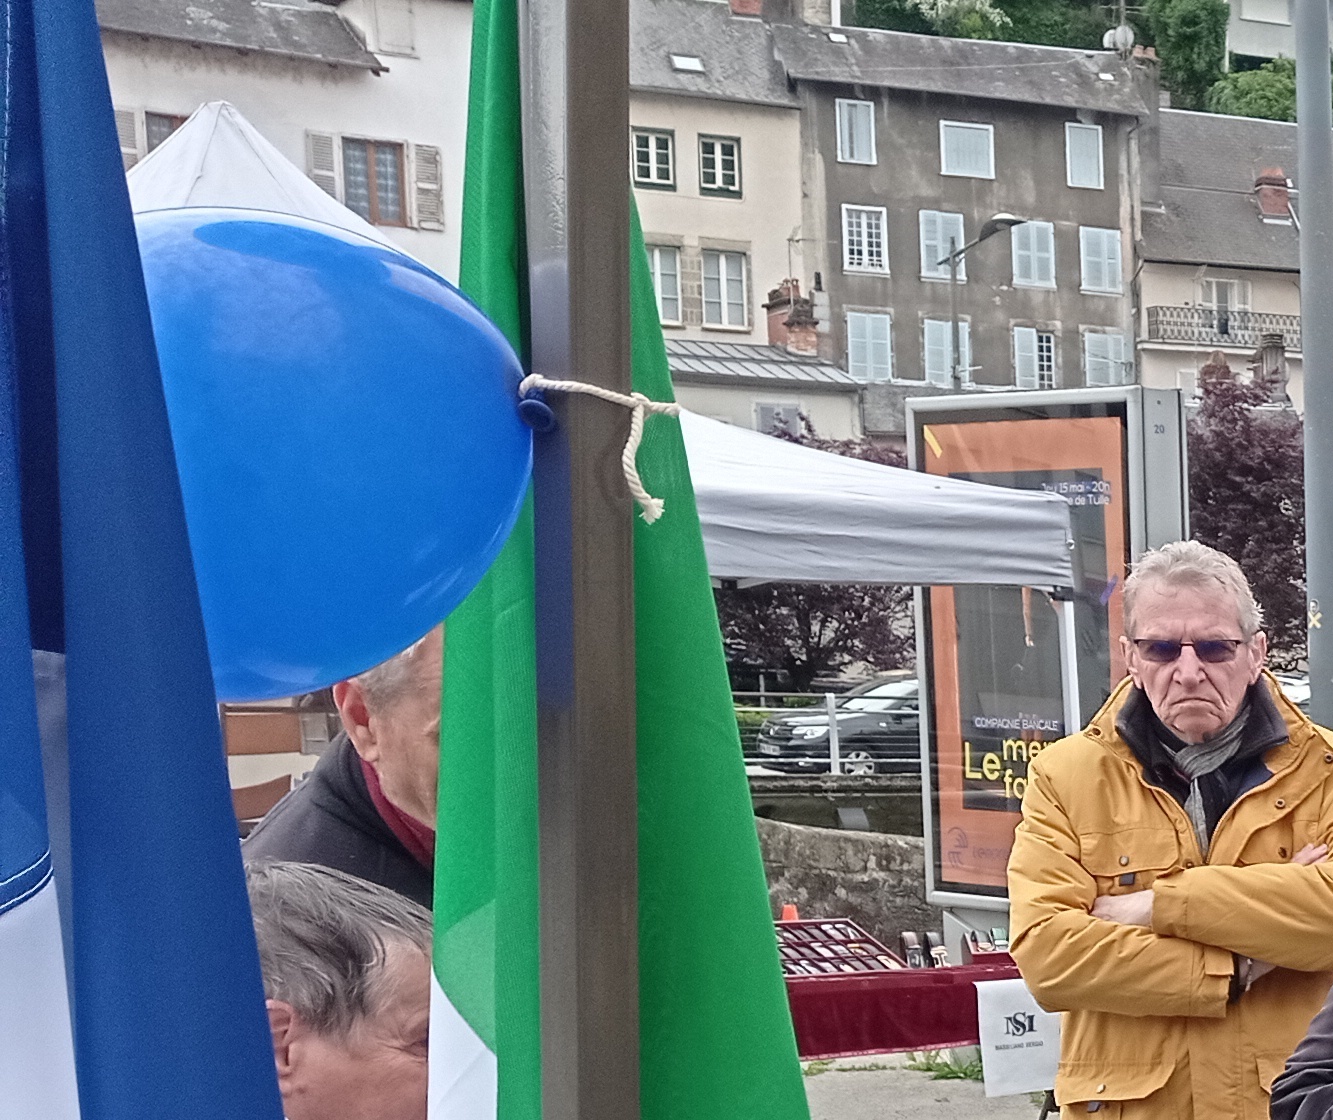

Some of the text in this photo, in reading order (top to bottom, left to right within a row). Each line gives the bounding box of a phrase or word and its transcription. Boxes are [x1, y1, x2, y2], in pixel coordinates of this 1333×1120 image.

[1154, 424, 1165, 434] 20
[1059, 482, 1068, 493] 15
[1069, 482, 1085, 493] mai
[1092, 480, 1111, 494] 20h
[1087, 493, 1111, 506] Tulle
[974, 716, 1059, 731] COMPAGNIE BANCALE
[964, 741, 1002, 781] Le
